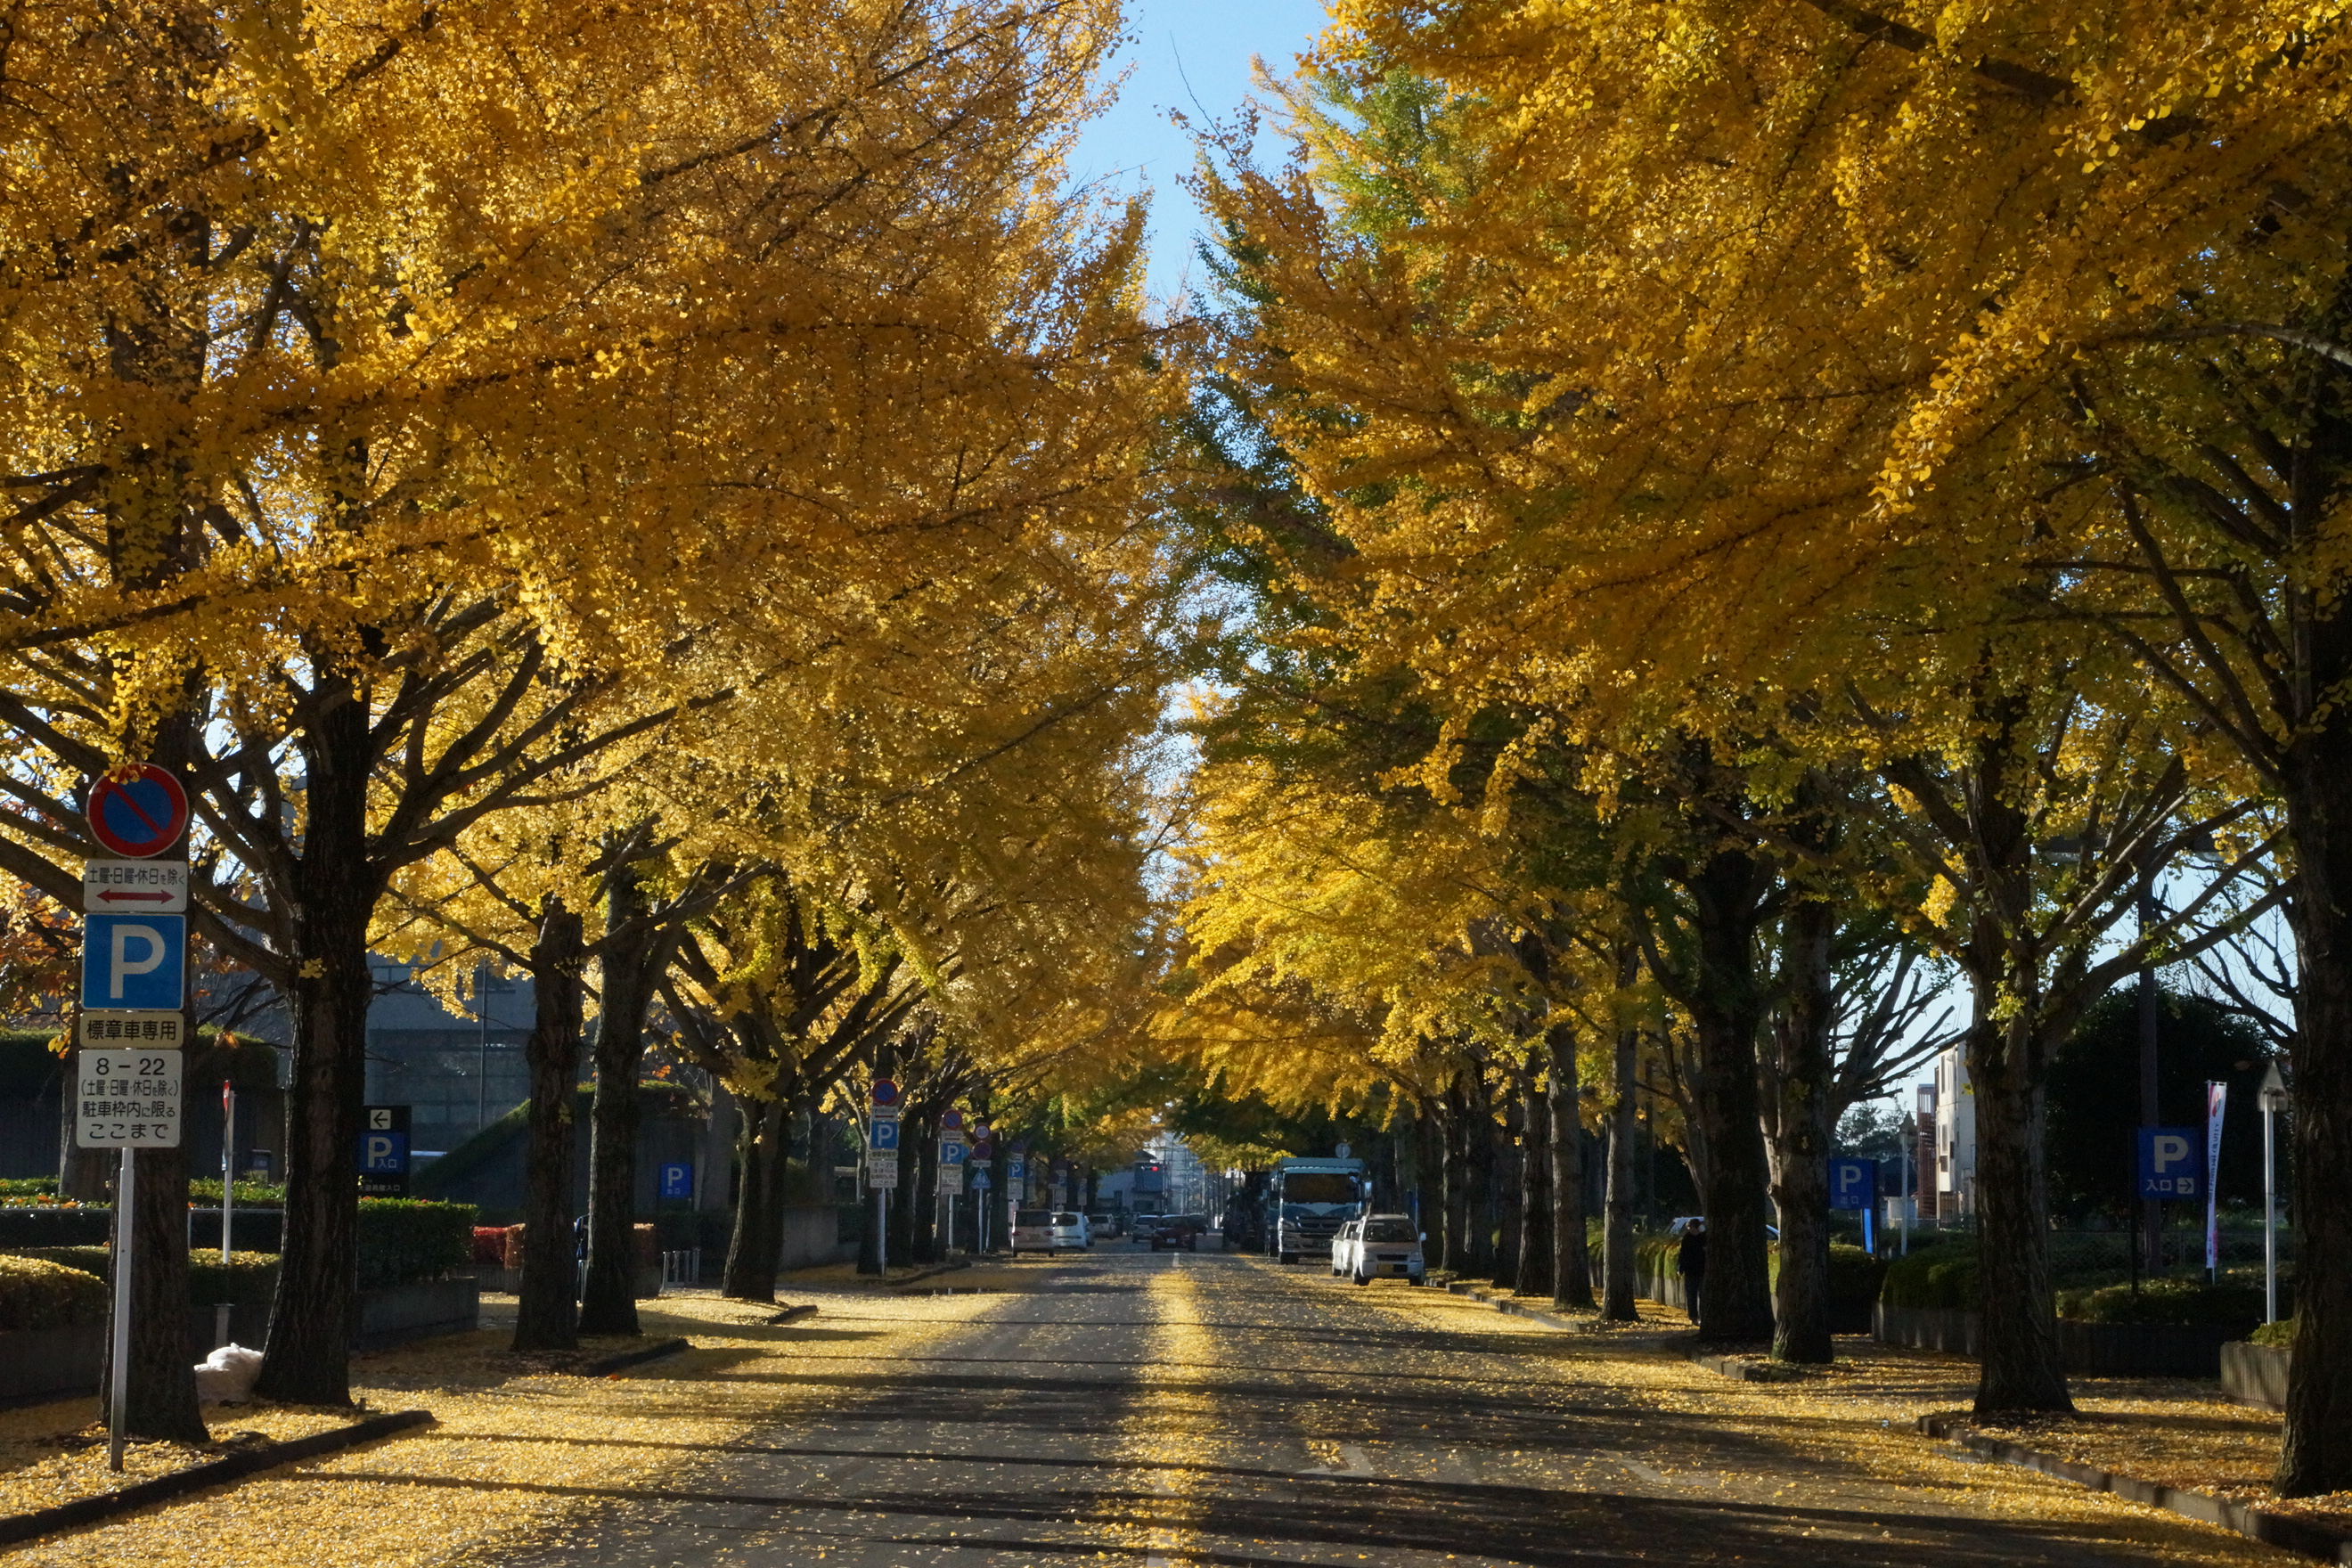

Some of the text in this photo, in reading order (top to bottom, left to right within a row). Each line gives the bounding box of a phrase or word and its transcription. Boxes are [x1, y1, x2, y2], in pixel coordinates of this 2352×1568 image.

[110, 924, 166, 999] P
[87, 1020, 176, 1041] 標章車専用
[83, 1101, 176, 1118] 駐車枠内に限る
[89, 1123, 168, 1139] ここまで
[878, 1124, 893, 1146] P
[367, 1136, 393, 1168] P
[947, 1145, 959, 1161] P
[2154, 1136, 2188, 1173] P
[378, 1158, 397, 1169] 入口
[1011, 1164, 1020, 1176] P
[667, 1167, 683, 1187] P
[1840, 1165, 1862, 1193] P
[2145, 1179, 2172, 1192] 入口
